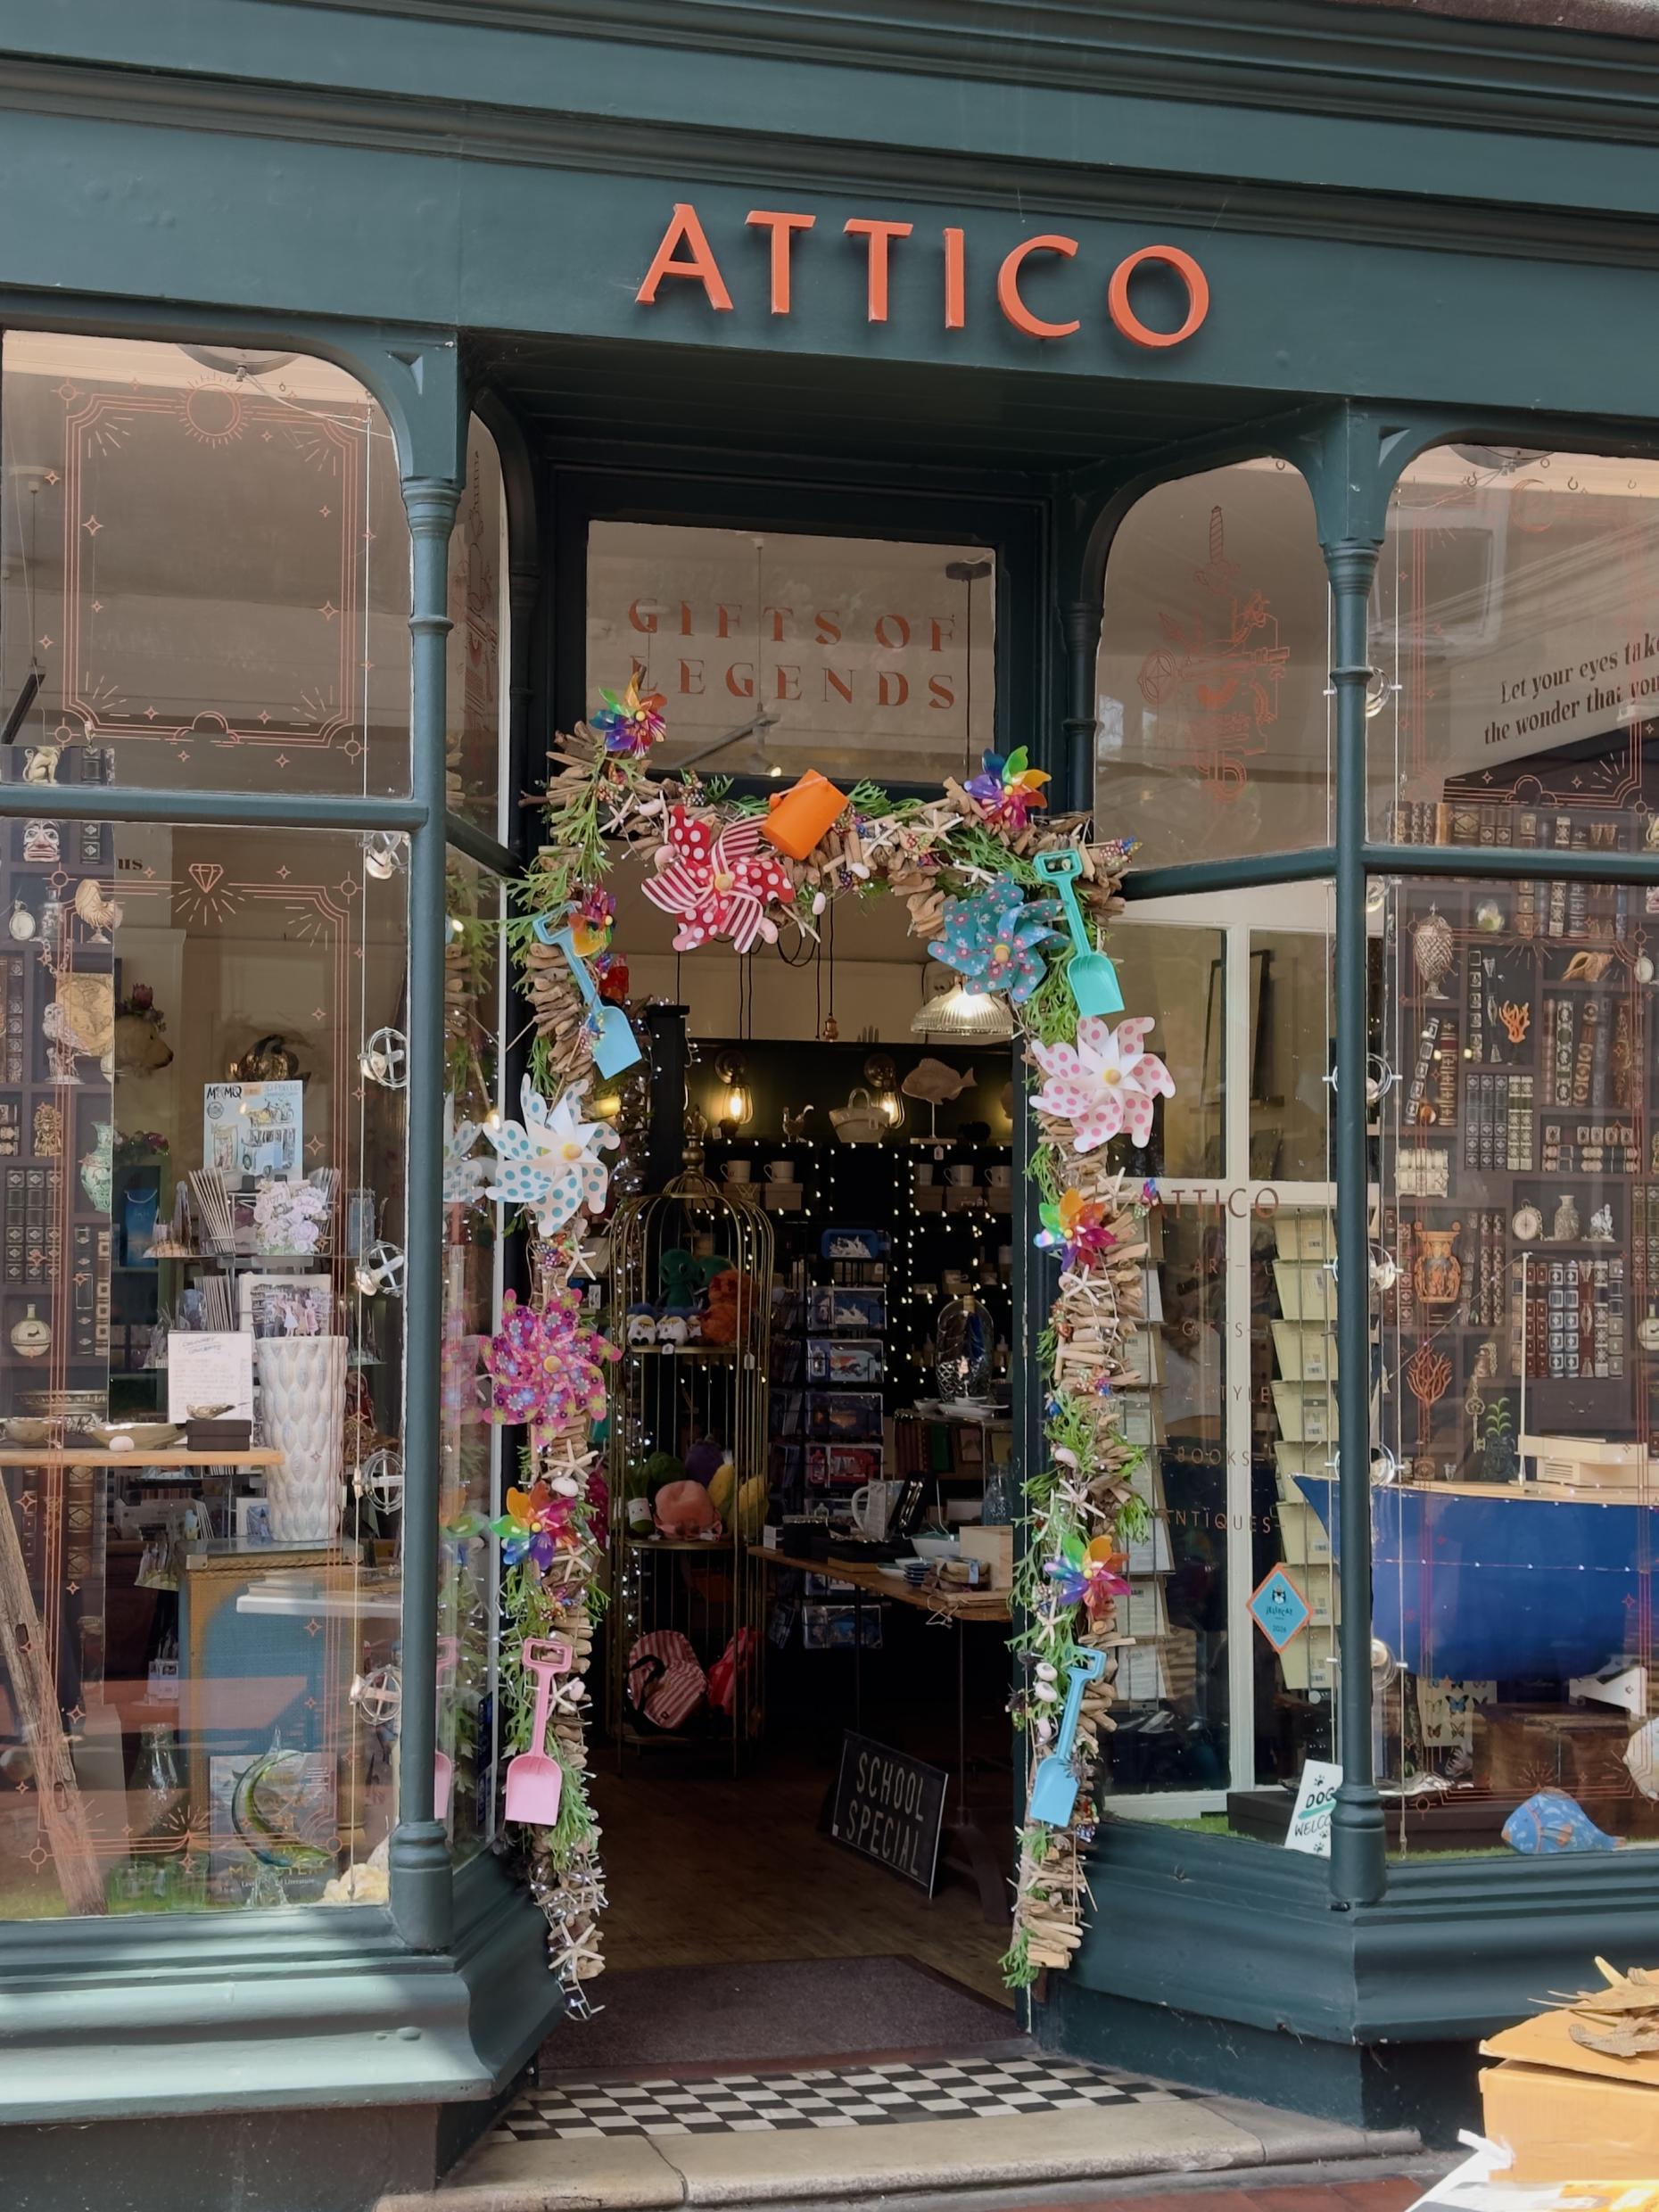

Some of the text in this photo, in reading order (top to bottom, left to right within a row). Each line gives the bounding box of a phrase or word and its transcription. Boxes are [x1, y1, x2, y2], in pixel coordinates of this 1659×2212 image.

[635, 203, 1209, 348] ATTICO
[628, 598, 956, 652] GIFTS OF
[630, 656, 956, 710] LEGENDS
[1500, 678, 1526, 705] Let
[1531, 666, 1573, 699] your
[1579, 651, 1619, 681] eyes
[1484, 721, 1510, 745] the
[1515, 699, 1581, 737] wonder
[1176, 1446, 1250, 1467] BOOKS
[856, 1751, 924, 1822] SCHOOL
[846, 1799, 919, 1876] SPECIAL
